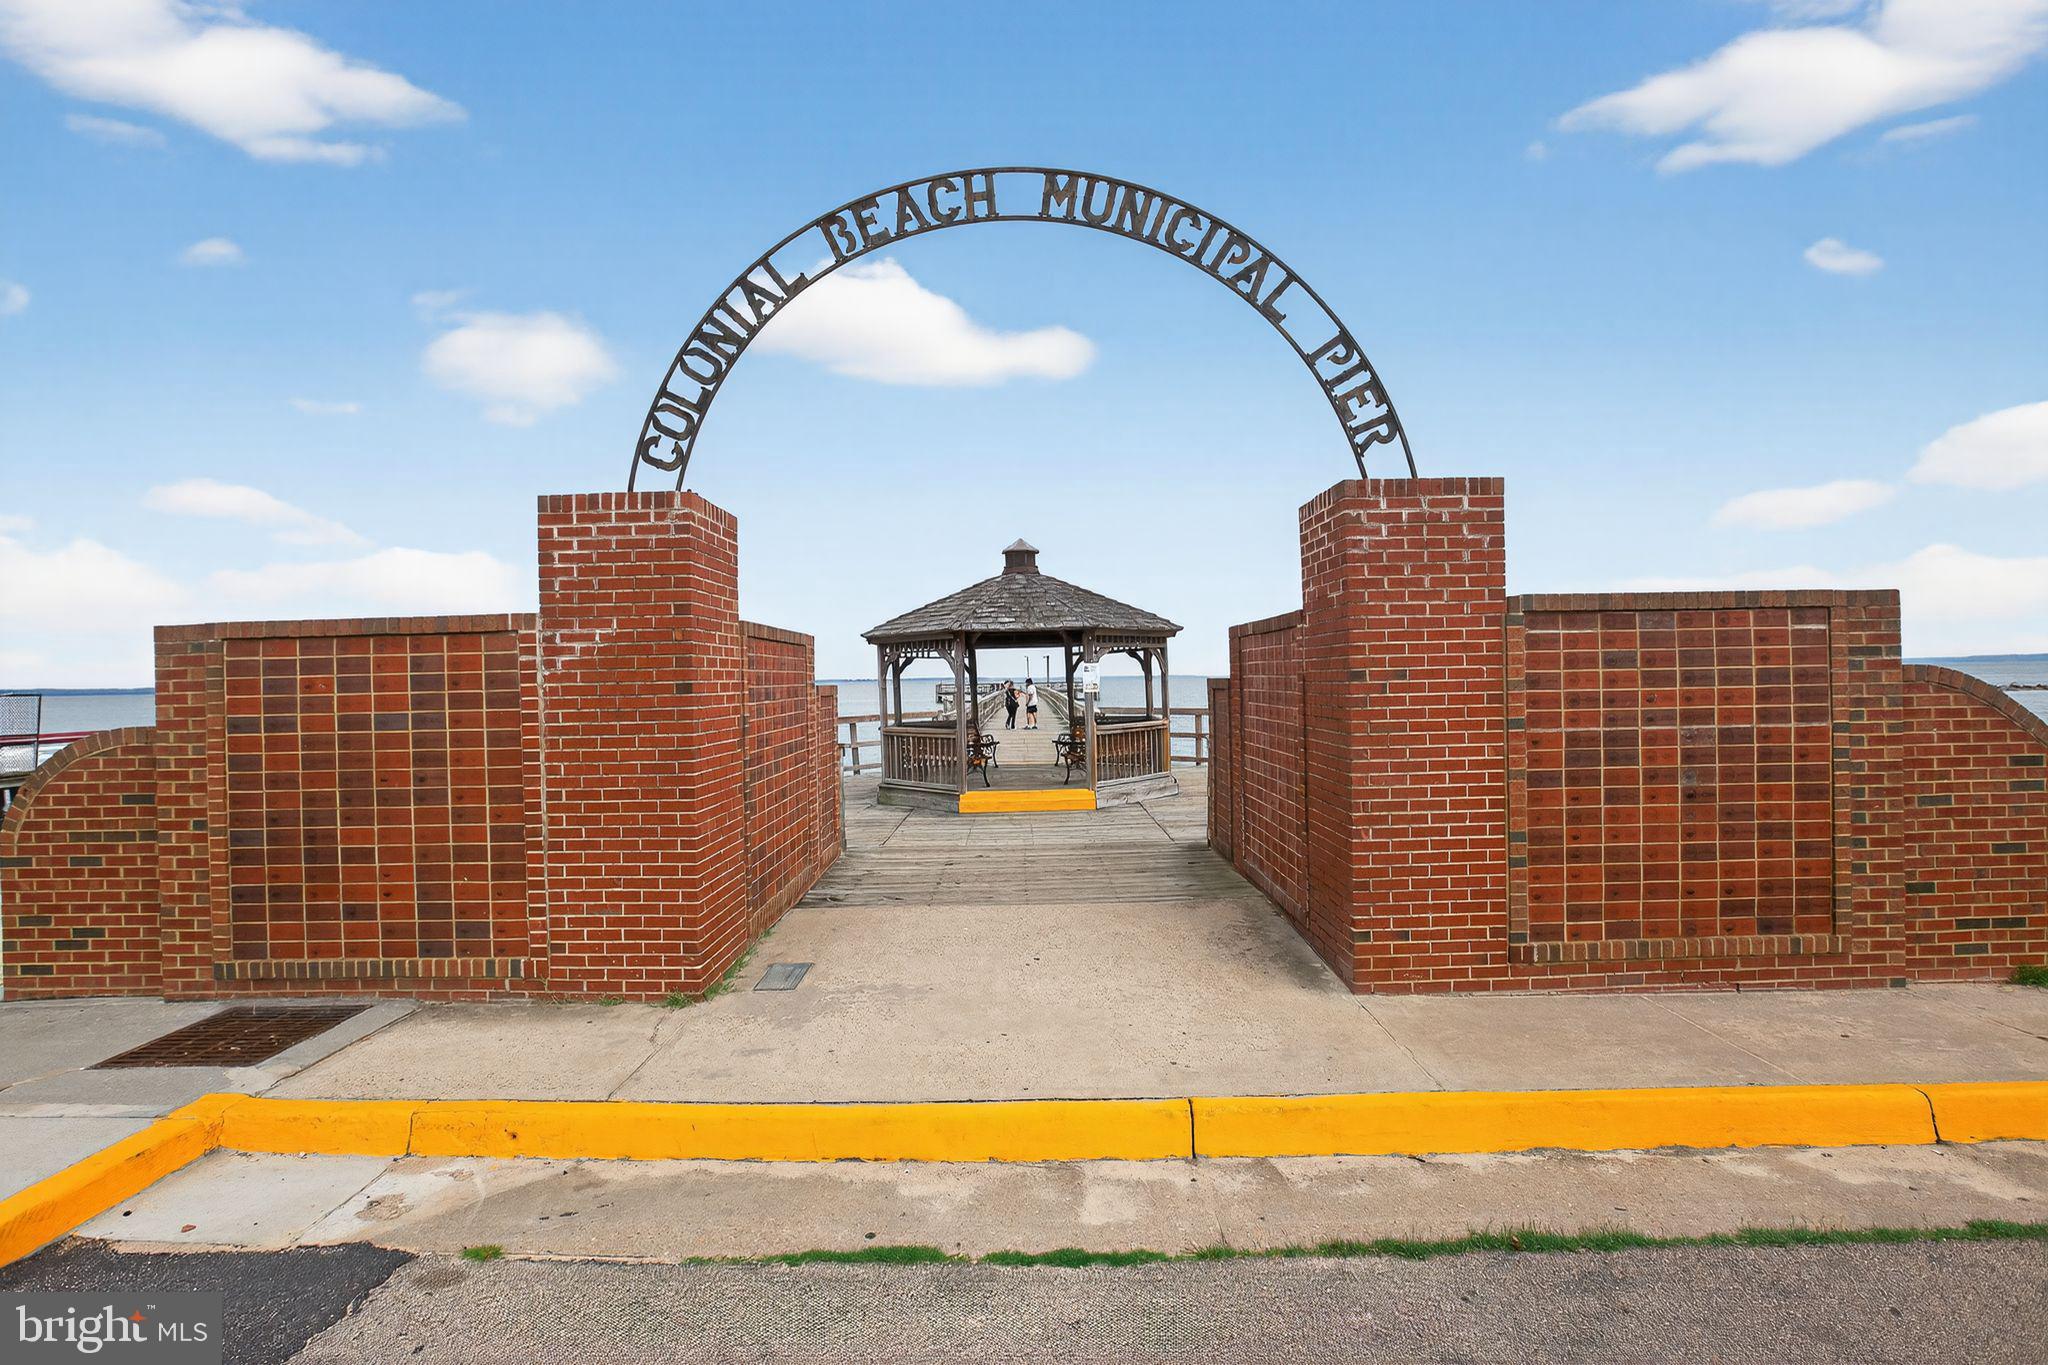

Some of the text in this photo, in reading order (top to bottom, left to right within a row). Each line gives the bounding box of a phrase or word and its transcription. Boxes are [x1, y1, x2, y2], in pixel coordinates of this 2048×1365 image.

[641, 172, 1399, 471] COLONIAL BEACH MUNICIPAL PIER
